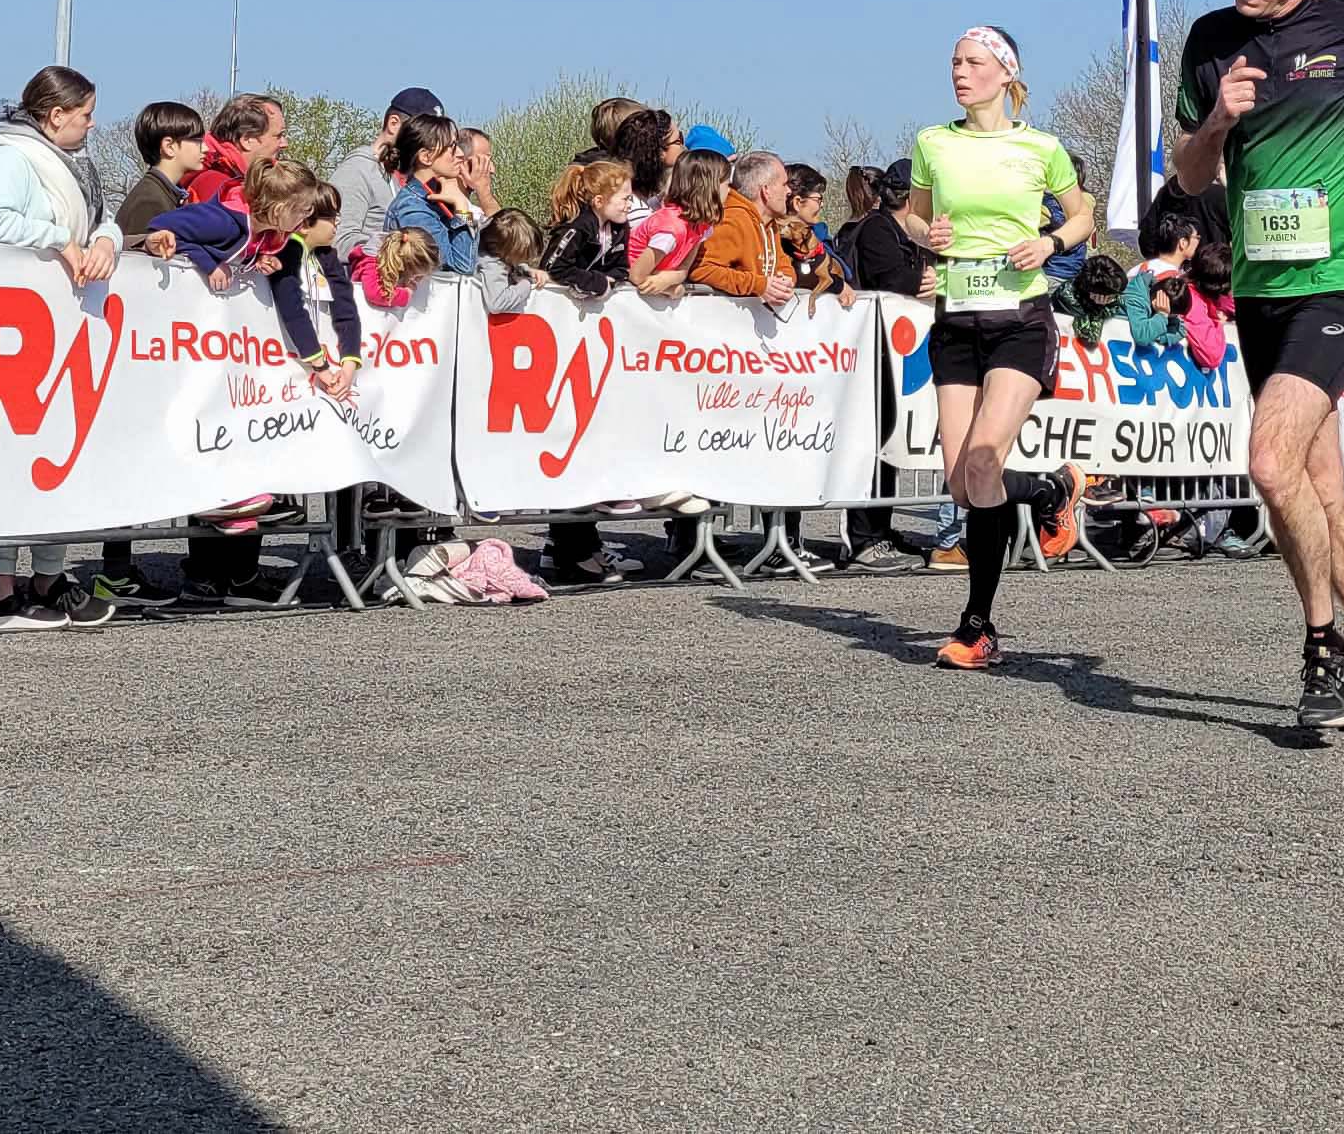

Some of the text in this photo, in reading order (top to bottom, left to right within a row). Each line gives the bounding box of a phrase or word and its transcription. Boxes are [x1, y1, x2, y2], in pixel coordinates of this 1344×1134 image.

[1261, 215, 1301, 231] 1633
[1264, 233, 1297, 242] FABIEN
[965, 275, 998, 288] 1537
[132, 330, 165, 360] La
[621, 339, 858, 374] La Roche-sur-Yon
[227, 373, 272, 409] Ville
[282, 378, 302, 402] et
[487, 313, 614, 478] Ry
[697, 381, 814, 428] Ville et Agglo
[196, 418, 232, 453] Le
[663, 422, 687, 452] Le
[1017, 414, 1096, 460] CHE
[1112, 419, 1175, 463] SUR
[1187, 421, 1232, 464] YON
